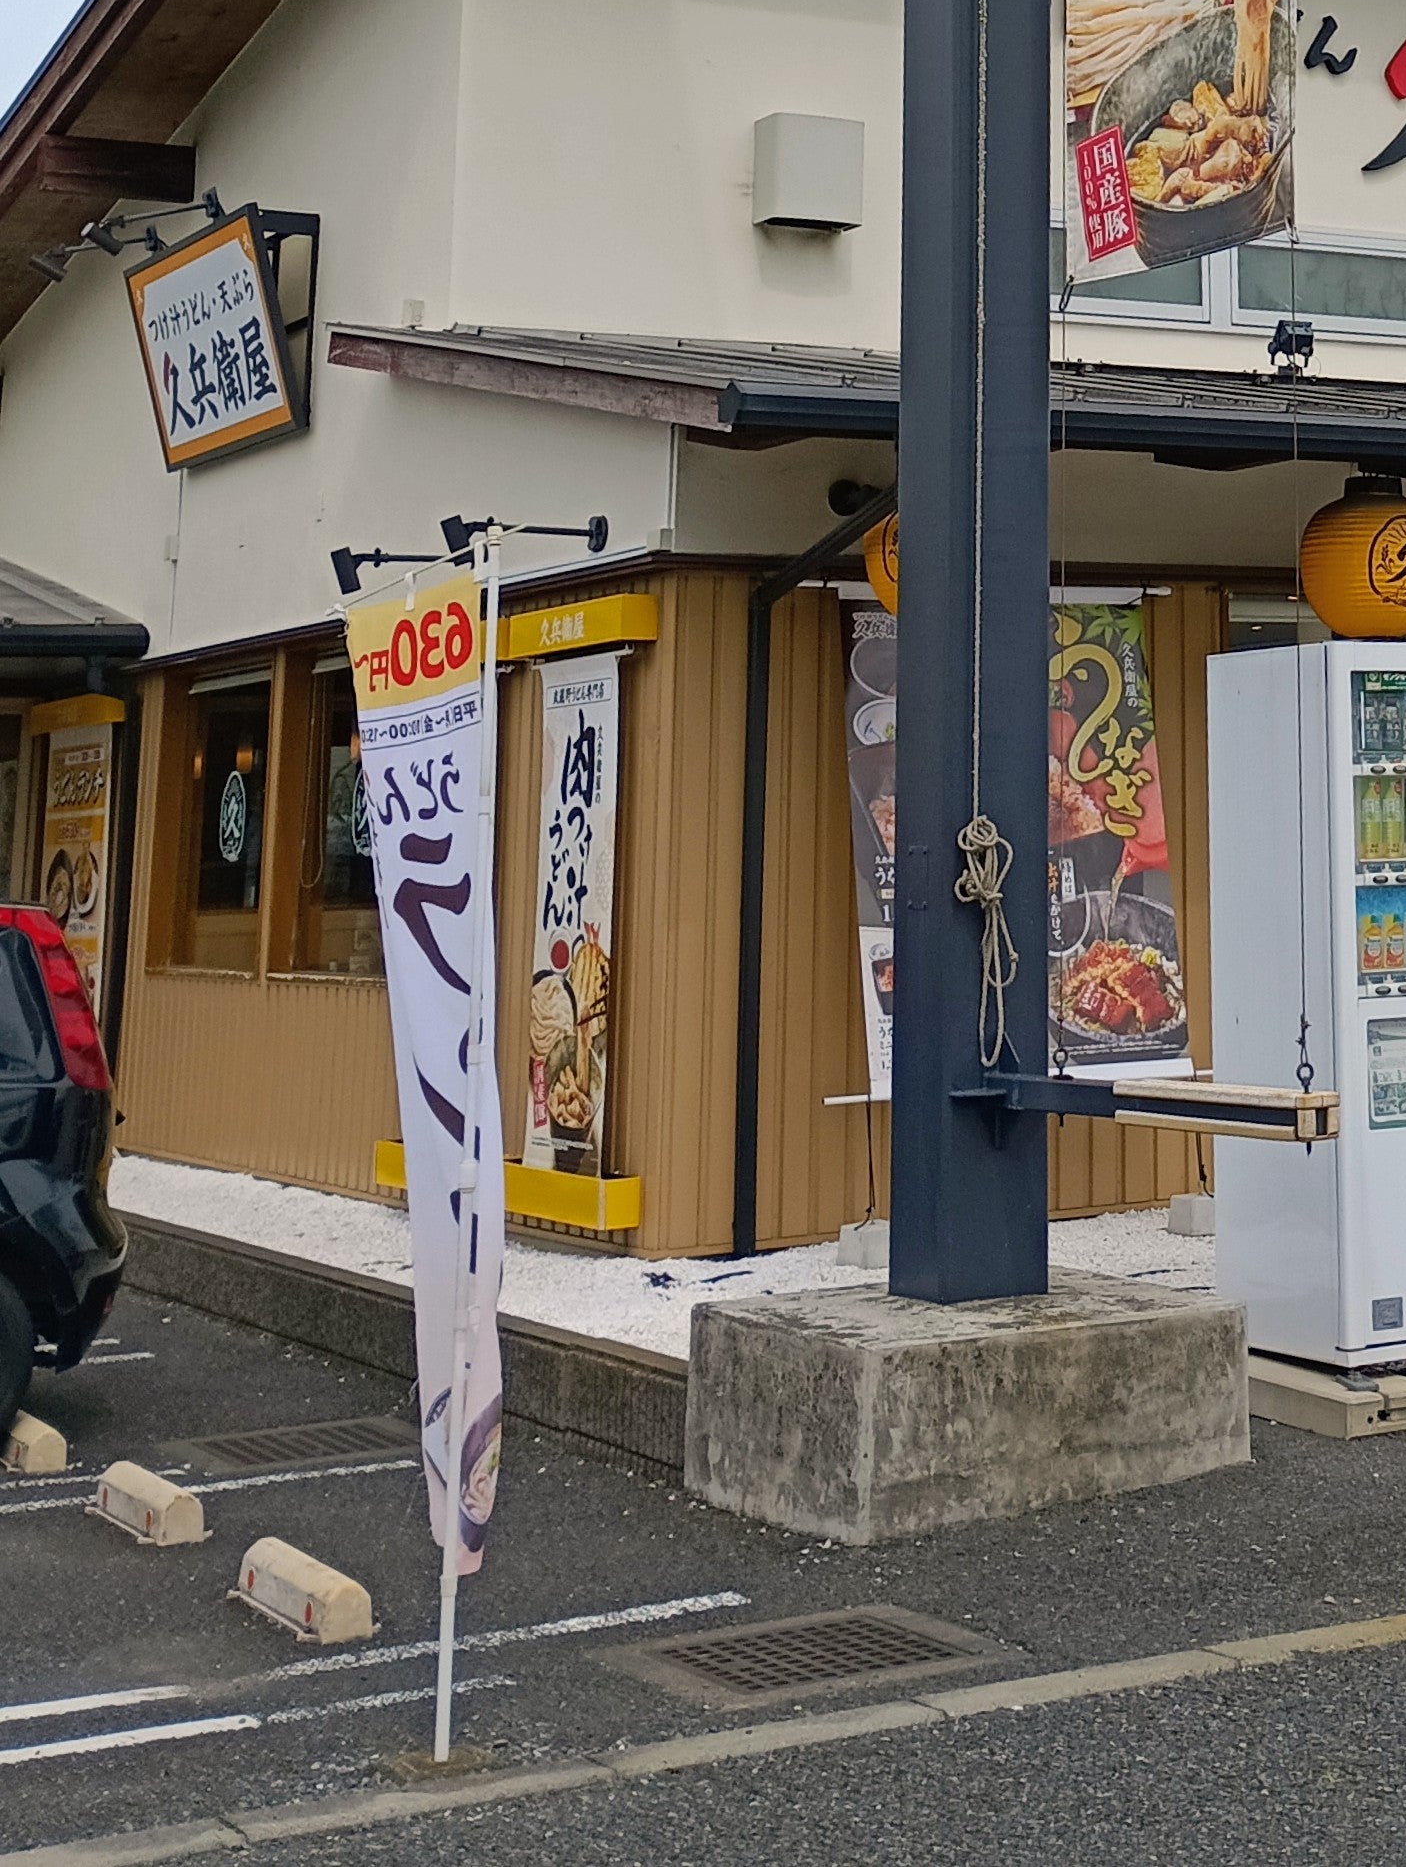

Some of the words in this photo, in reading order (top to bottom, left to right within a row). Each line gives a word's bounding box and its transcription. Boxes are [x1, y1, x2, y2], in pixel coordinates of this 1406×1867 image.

[1297, 9, 1358, 76] ん
[1093, 137, 1130, 245] 国産豚
[163, 315, 278, 437] 久兵衛屋
[539, 611, 585, 646] 久兵衛屋
[1121, 642, 1139, 708] 久兵衛屋の
